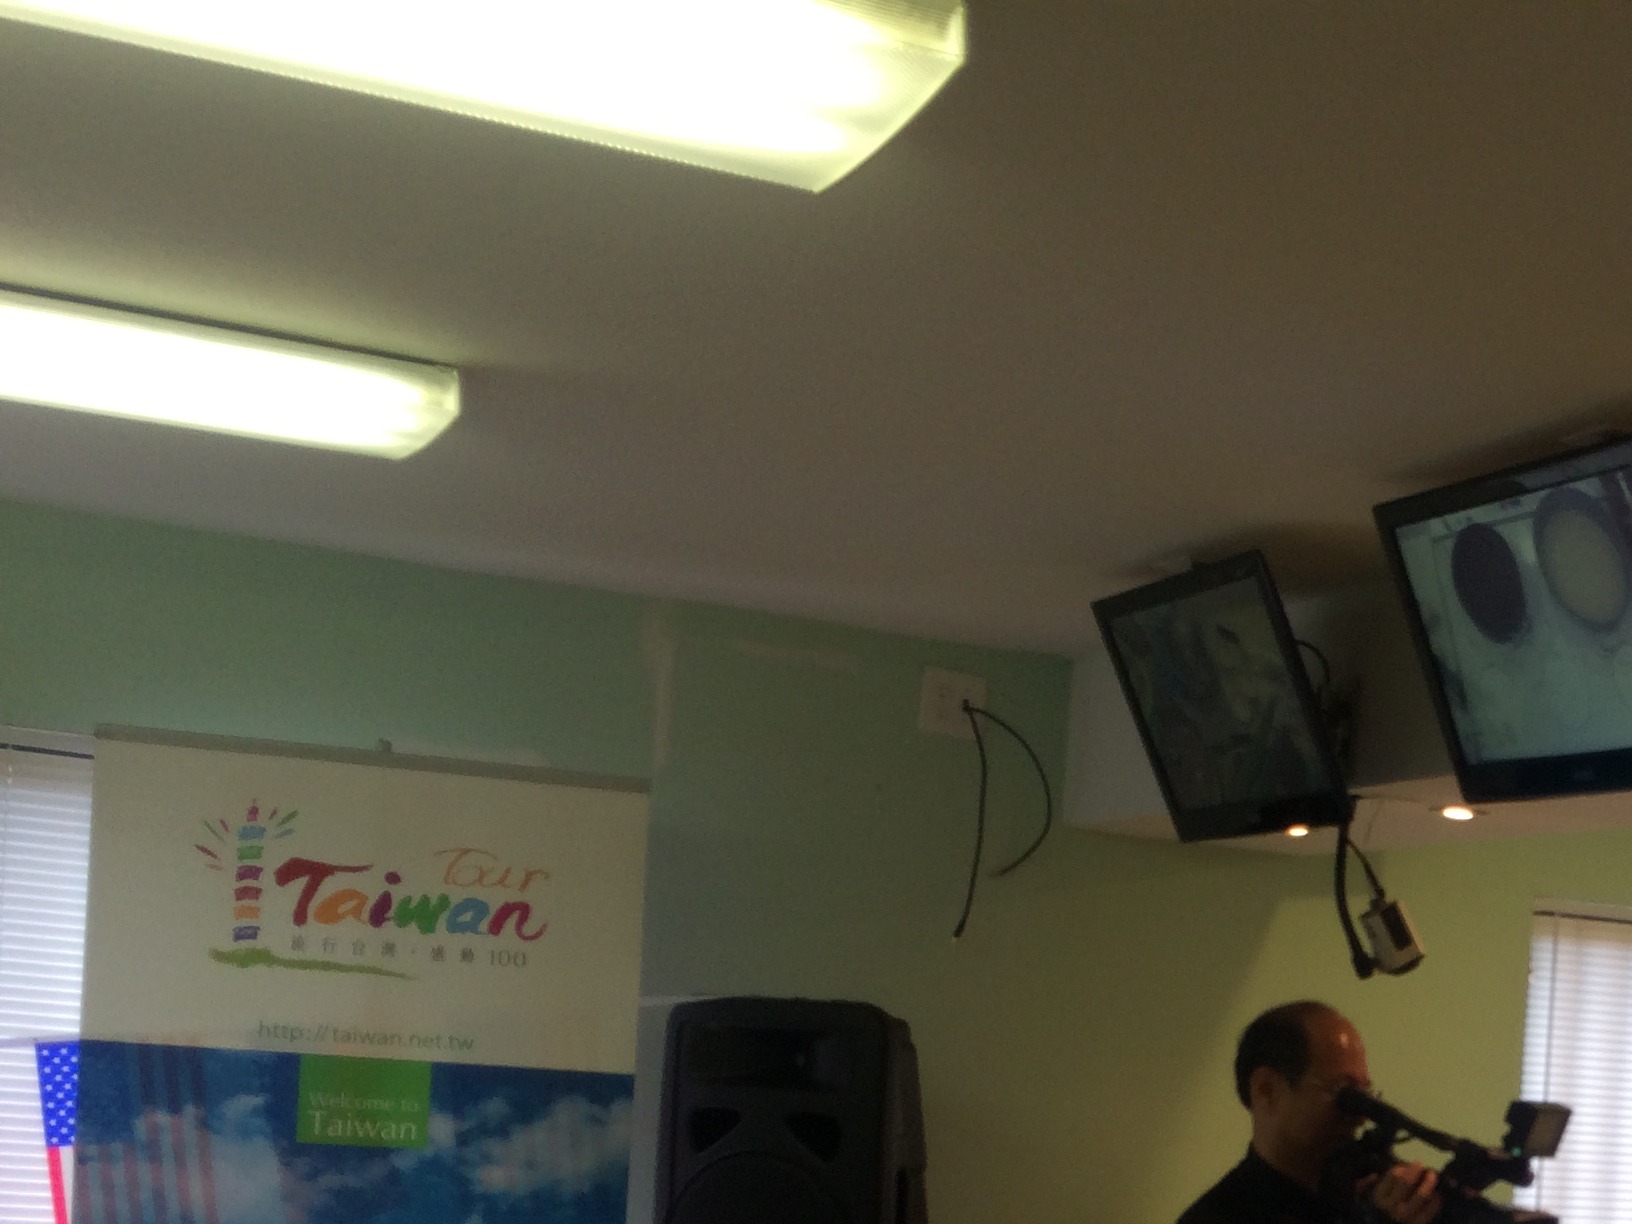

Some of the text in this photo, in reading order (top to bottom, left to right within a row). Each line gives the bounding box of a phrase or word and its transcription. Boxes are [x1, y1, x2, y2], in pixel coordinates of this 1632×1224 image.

[434, 846, 551, 893] Tour
[273, 856, 548, 941] Taiwan
[308, 1109, 418, 1141] Taiwan
